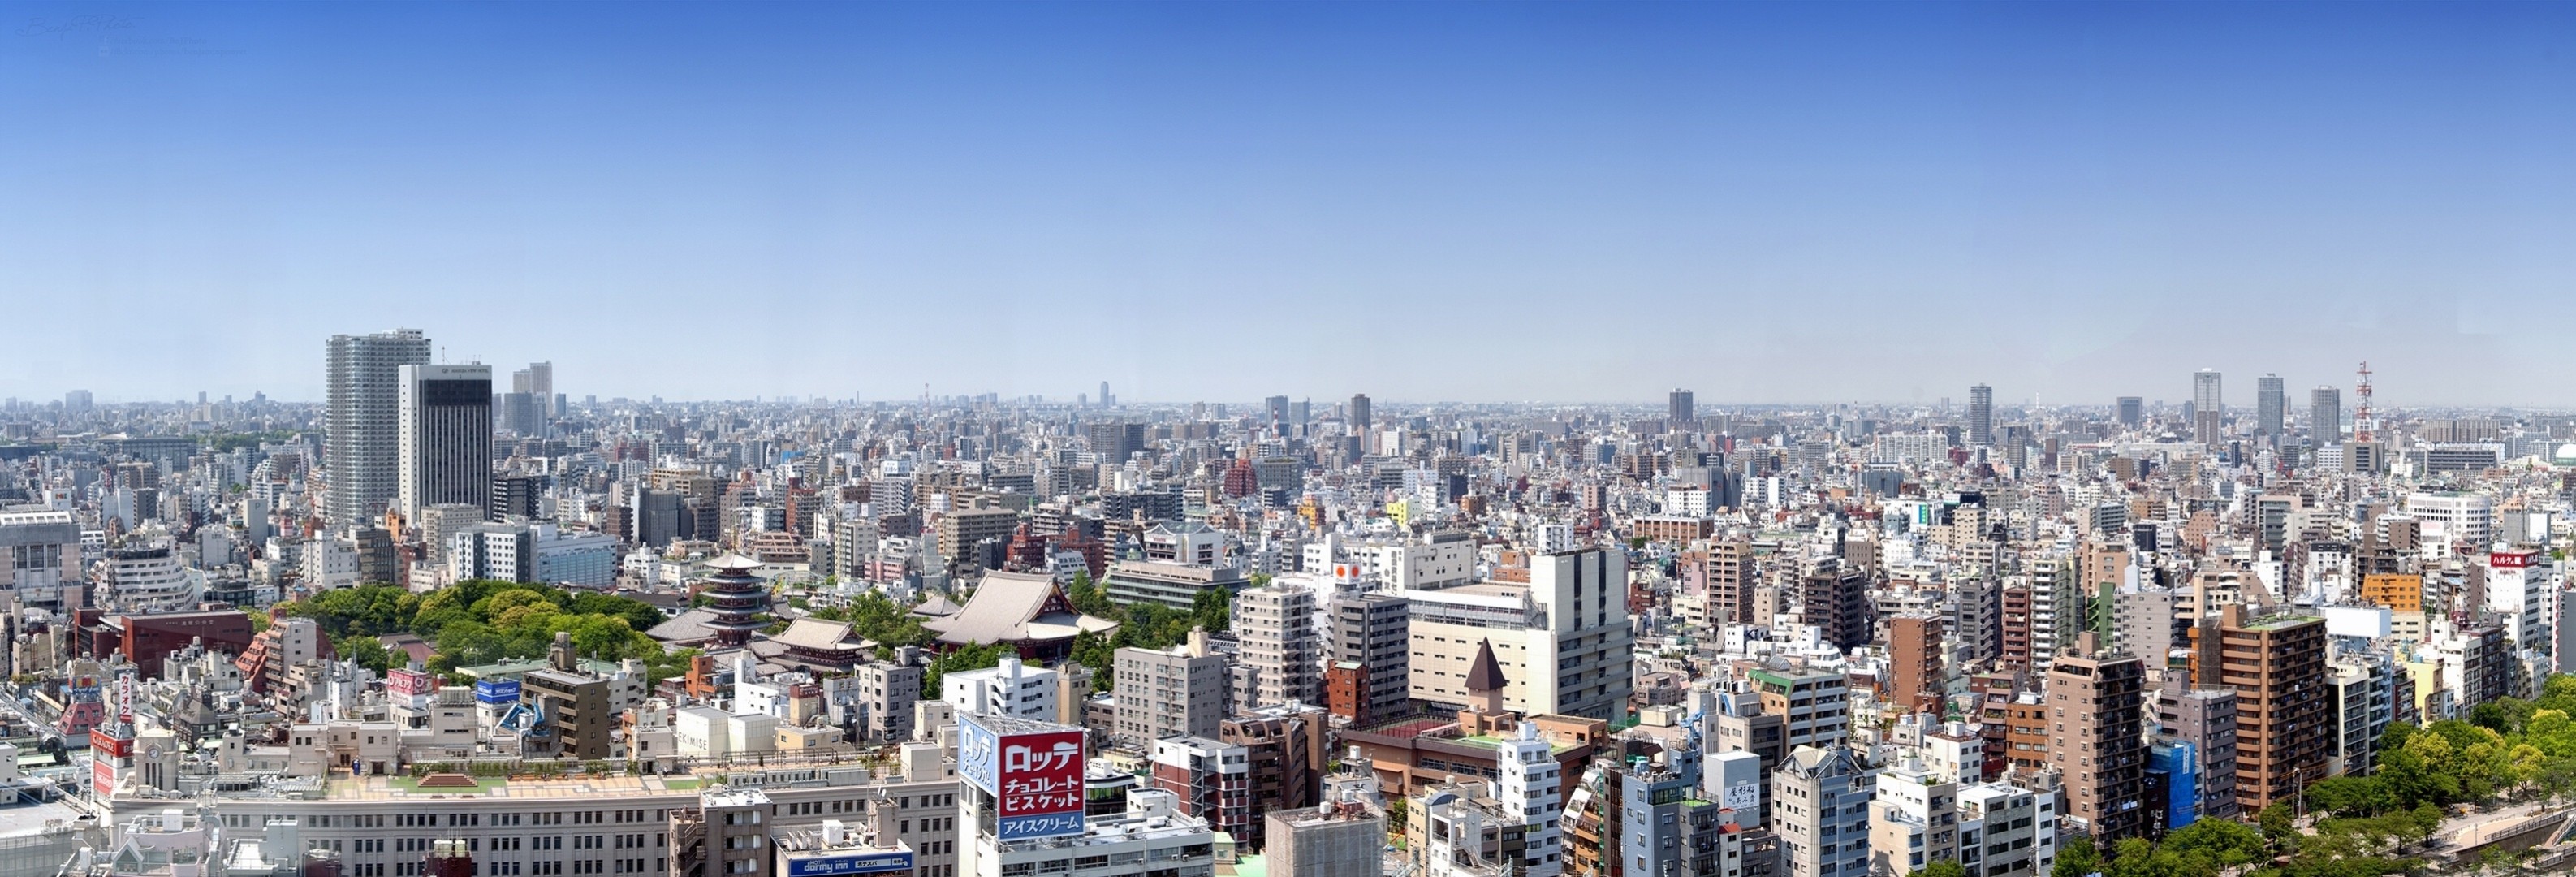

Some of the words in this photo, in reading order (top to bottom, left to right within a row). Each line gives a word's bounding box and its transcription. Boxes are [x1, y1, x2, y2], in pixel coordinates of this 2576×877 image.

[255, 502, 261, 510] P
[121, 676, 130, 715] カラオケ
[93, 734, 114, 752] KARAOKE
[679, 732, 707, 750] EKIMISE
[963, 725, 991, 767] ロッテ
[1005, 741, 1079, 773] ロッテ
[1005, 775, 1079, 794] チョコレート
[1006, 792, 1079, 811] ビスケット
[1004, 815, 1080, 835] アイスクリーム
[804, 861, 833, 873] dormy
